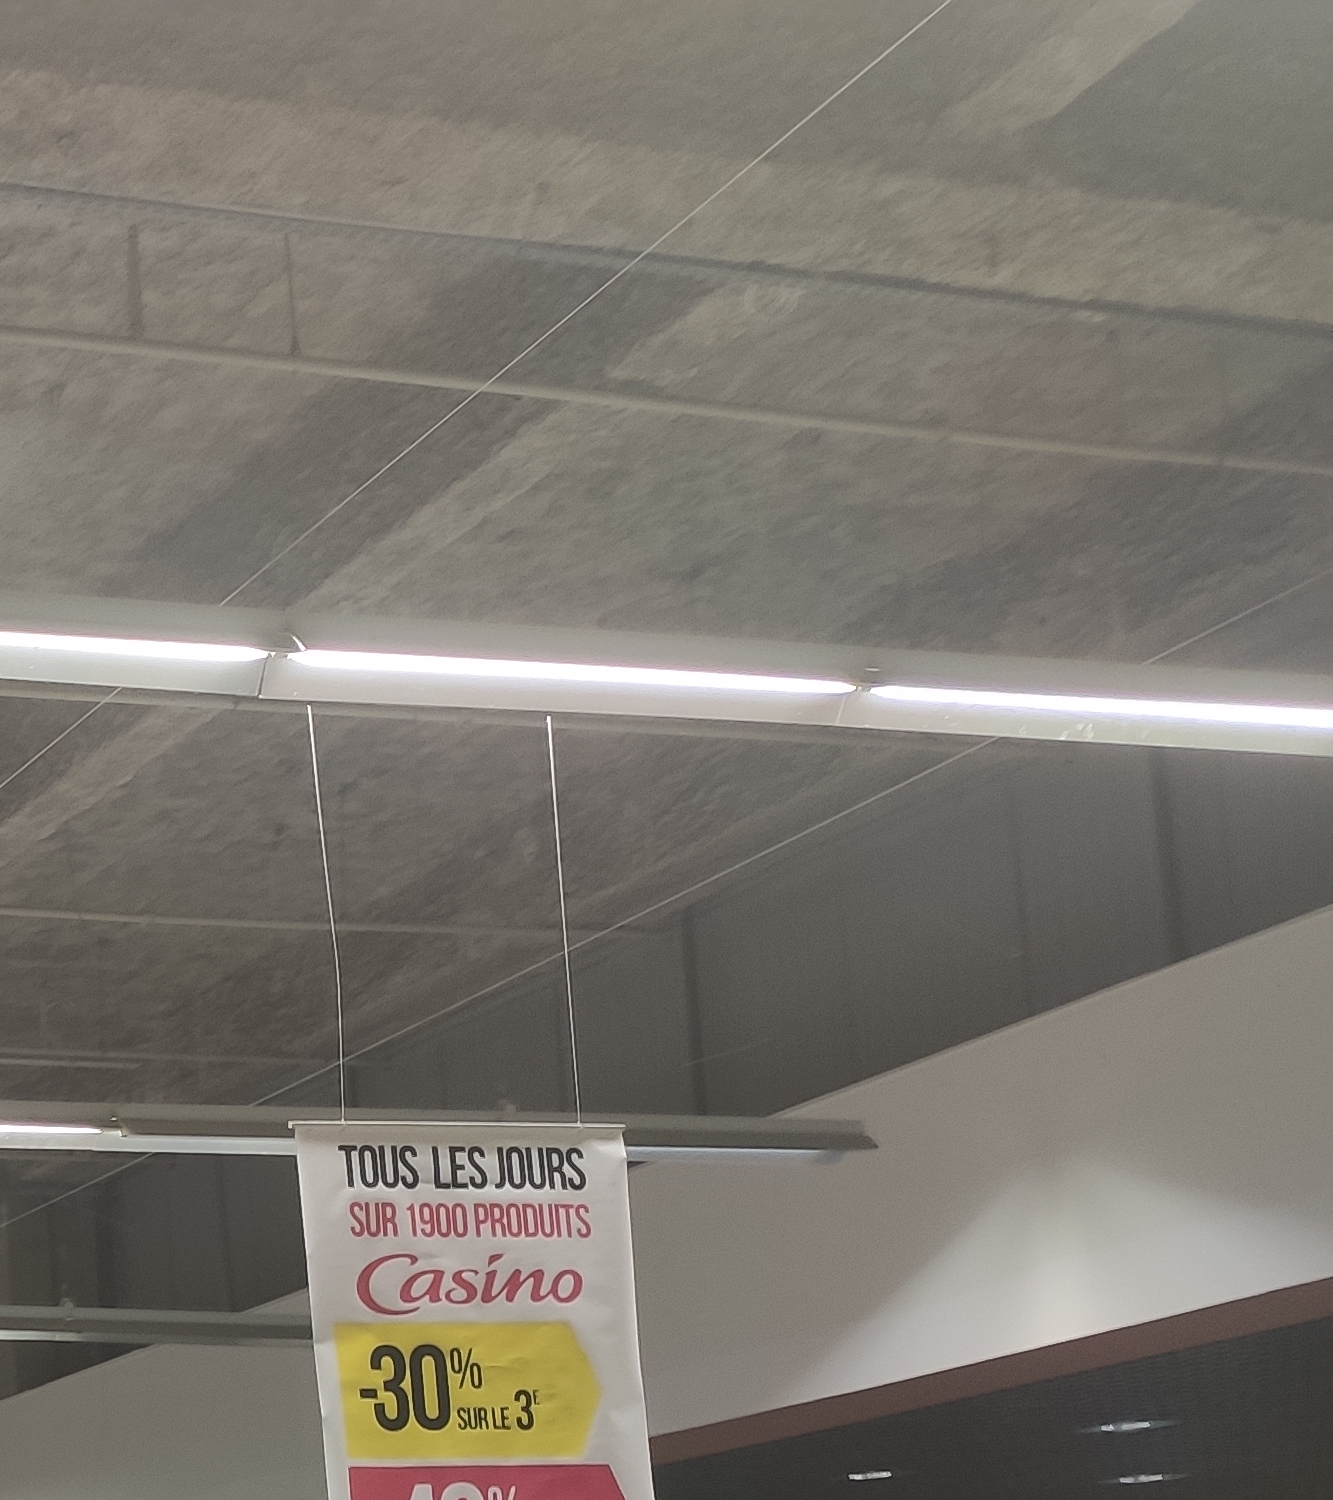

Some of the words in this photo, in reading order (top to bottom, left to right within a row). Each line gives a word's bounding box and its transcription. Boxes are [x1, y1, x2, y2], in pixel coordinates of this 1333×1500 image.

[338, 1145, 420, 1189] TOUS
[432, 1146, 488, 1190] LES
[494, 1146, 587, 1191] JOURS
[349, 1201, 398, 1238] SUR
[405, 1202, 469, 1238] 1900
[473, 1203, 592, 1239] PRODUITS
[356, 1252, 583, 1316] Casino
[359, 1344, 483, 1432] -30%
[457, 1407, 488, 1431] SUR
[489, 1406, 511, 1430] LE
